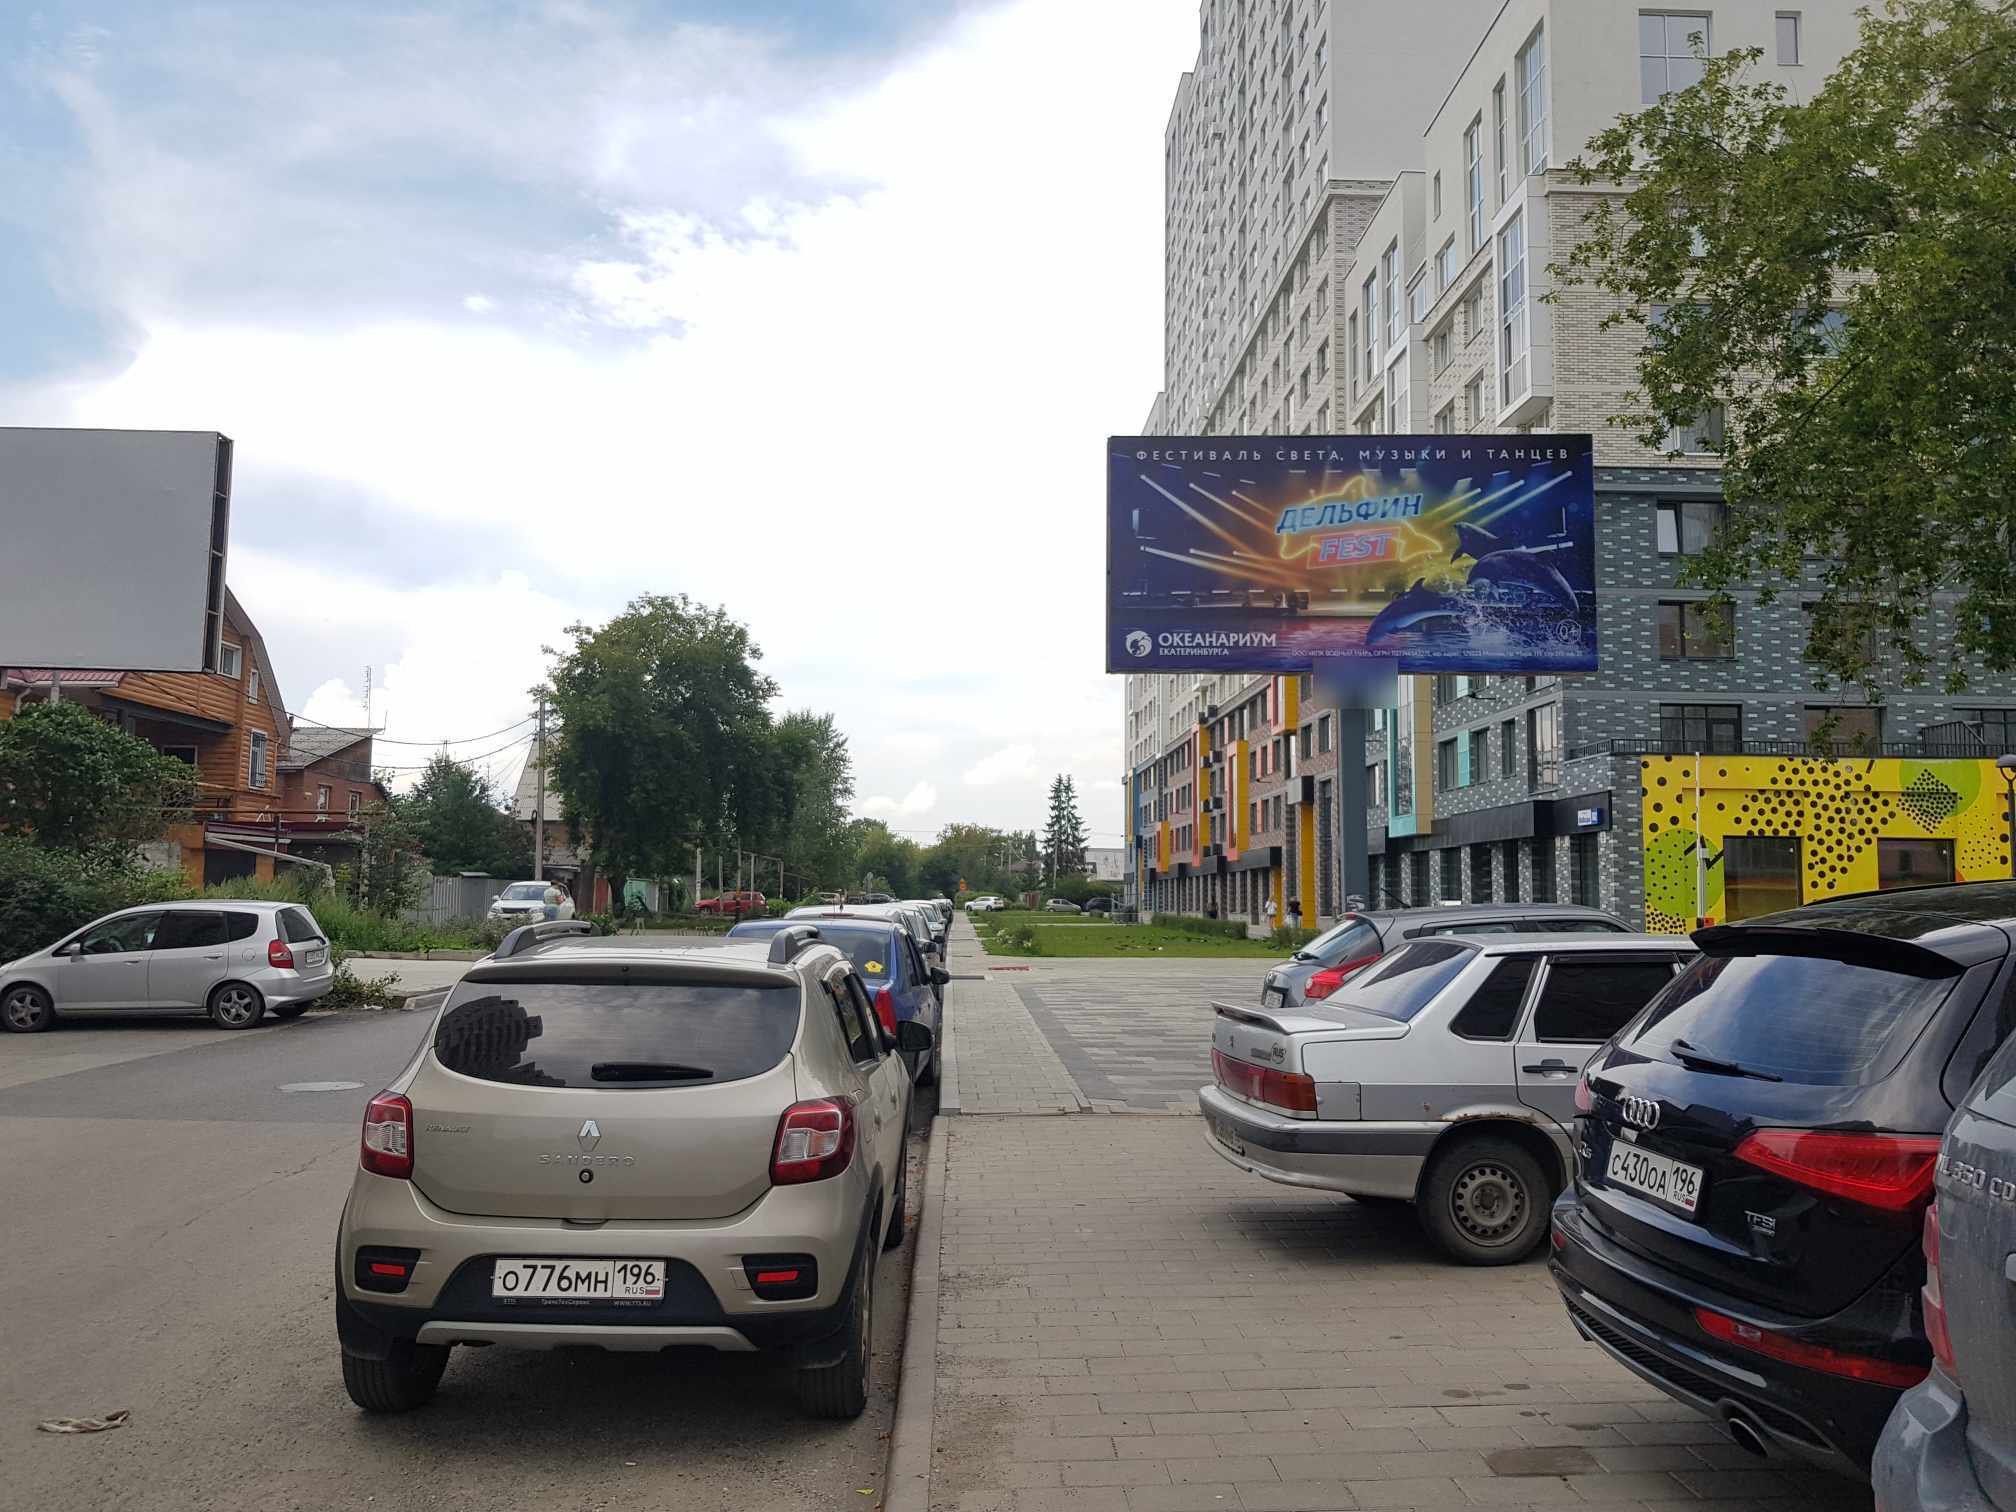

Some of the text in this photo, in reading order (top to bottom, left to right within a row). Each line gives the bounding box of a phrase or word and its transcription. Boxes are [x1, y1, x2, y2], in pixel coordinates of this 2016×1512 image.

[1136, 449, 1568, 462] ФЕСТИВАЛЬ СВЕТА, МУЗЫКИ И ТАНЦЕВ
[1275, 493, 1423, 535] ДЕЛЬФИН
[1319, 533, 1392, 561] FEST
[1158, 632, 1277, 647] ОКЕАНАРИУМ
[1159, 647, 1229, 656] ЕКАТЕРИНБУРГА
[537, 1154, 637, 1168] SANDERO
[1672, 1166, 1696, 1195] 196
[617, 1264, 656, 1285] 196
[625, 1287, 645, 1295] RUS
